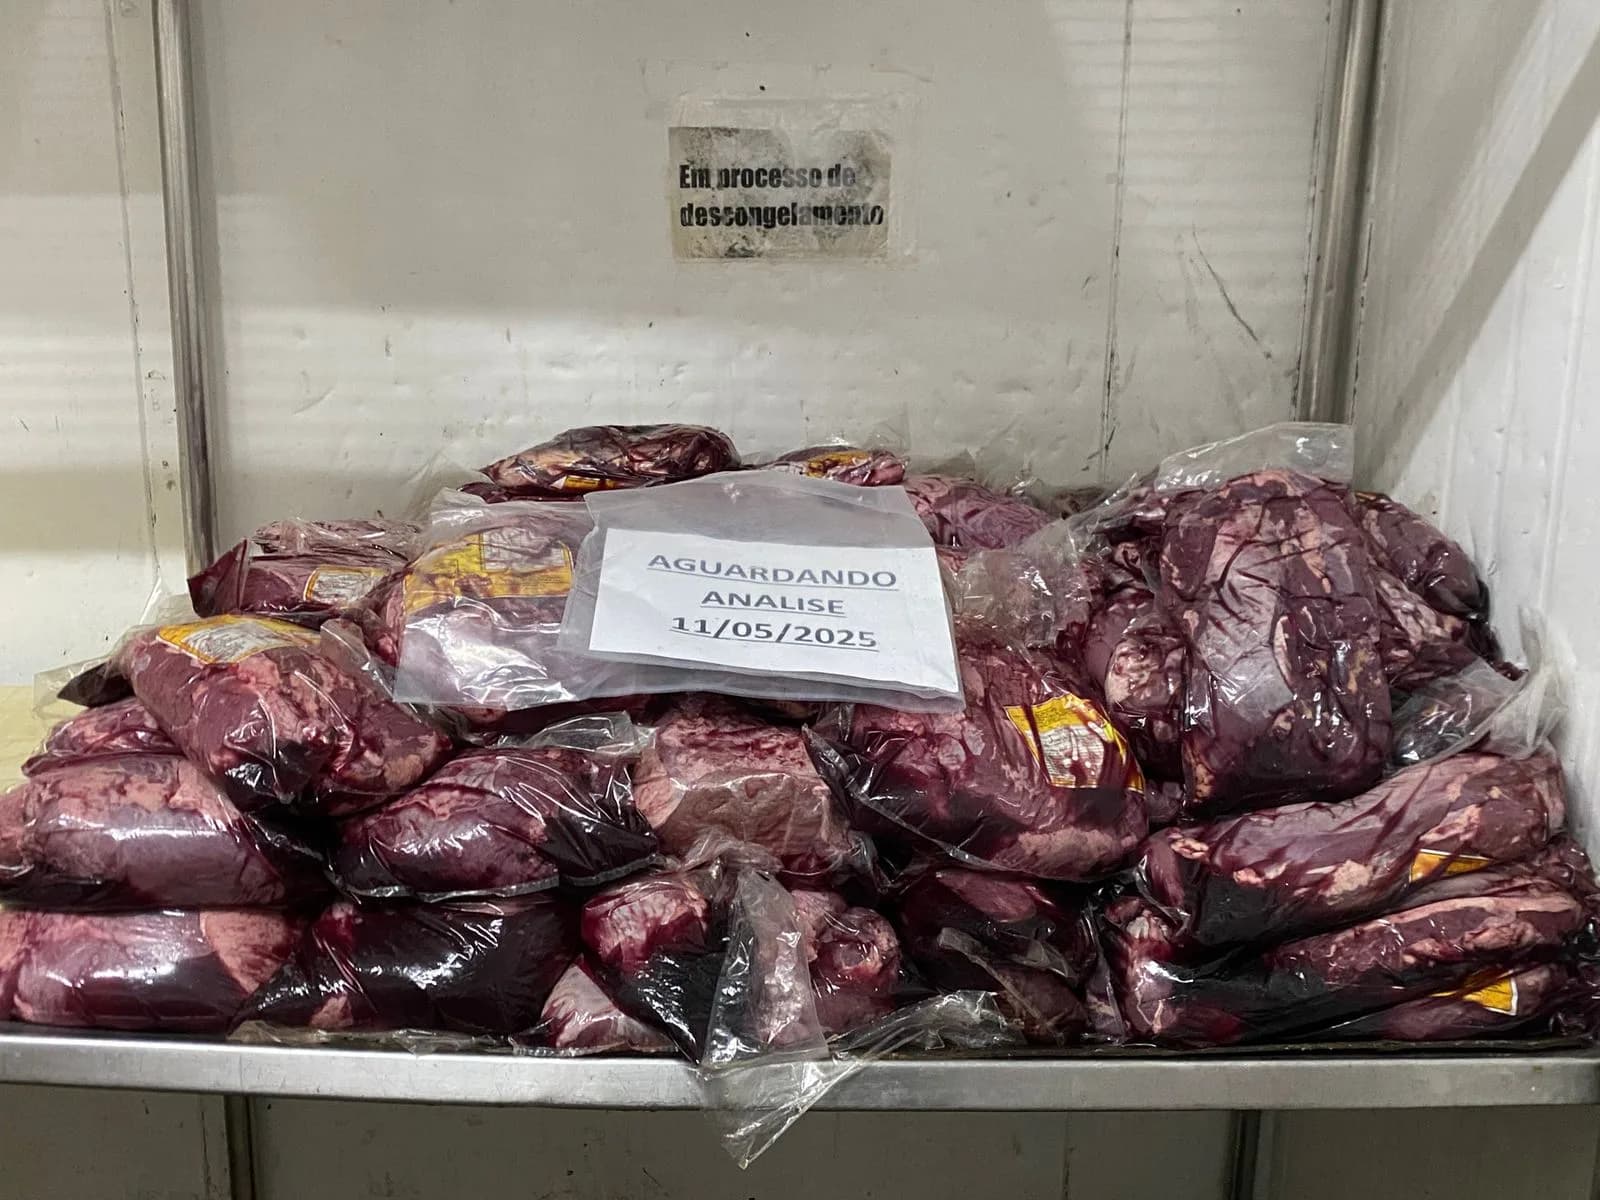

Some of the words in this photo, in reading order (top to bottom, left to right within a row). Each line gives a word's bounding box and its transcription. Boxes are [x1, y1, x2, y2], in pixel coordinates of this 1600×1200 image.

[679, 164, 711, 189] Em
[717, 167, 823, 191] processo
[827, 163, 856, 188] de
[680, 202, 884, 229] descongelamento
[648, 554, 898, 588] AGUARDANDO
[701, 590, 846, 615] ANALISE
[671, 616, 878, 648] 11/05/2025
